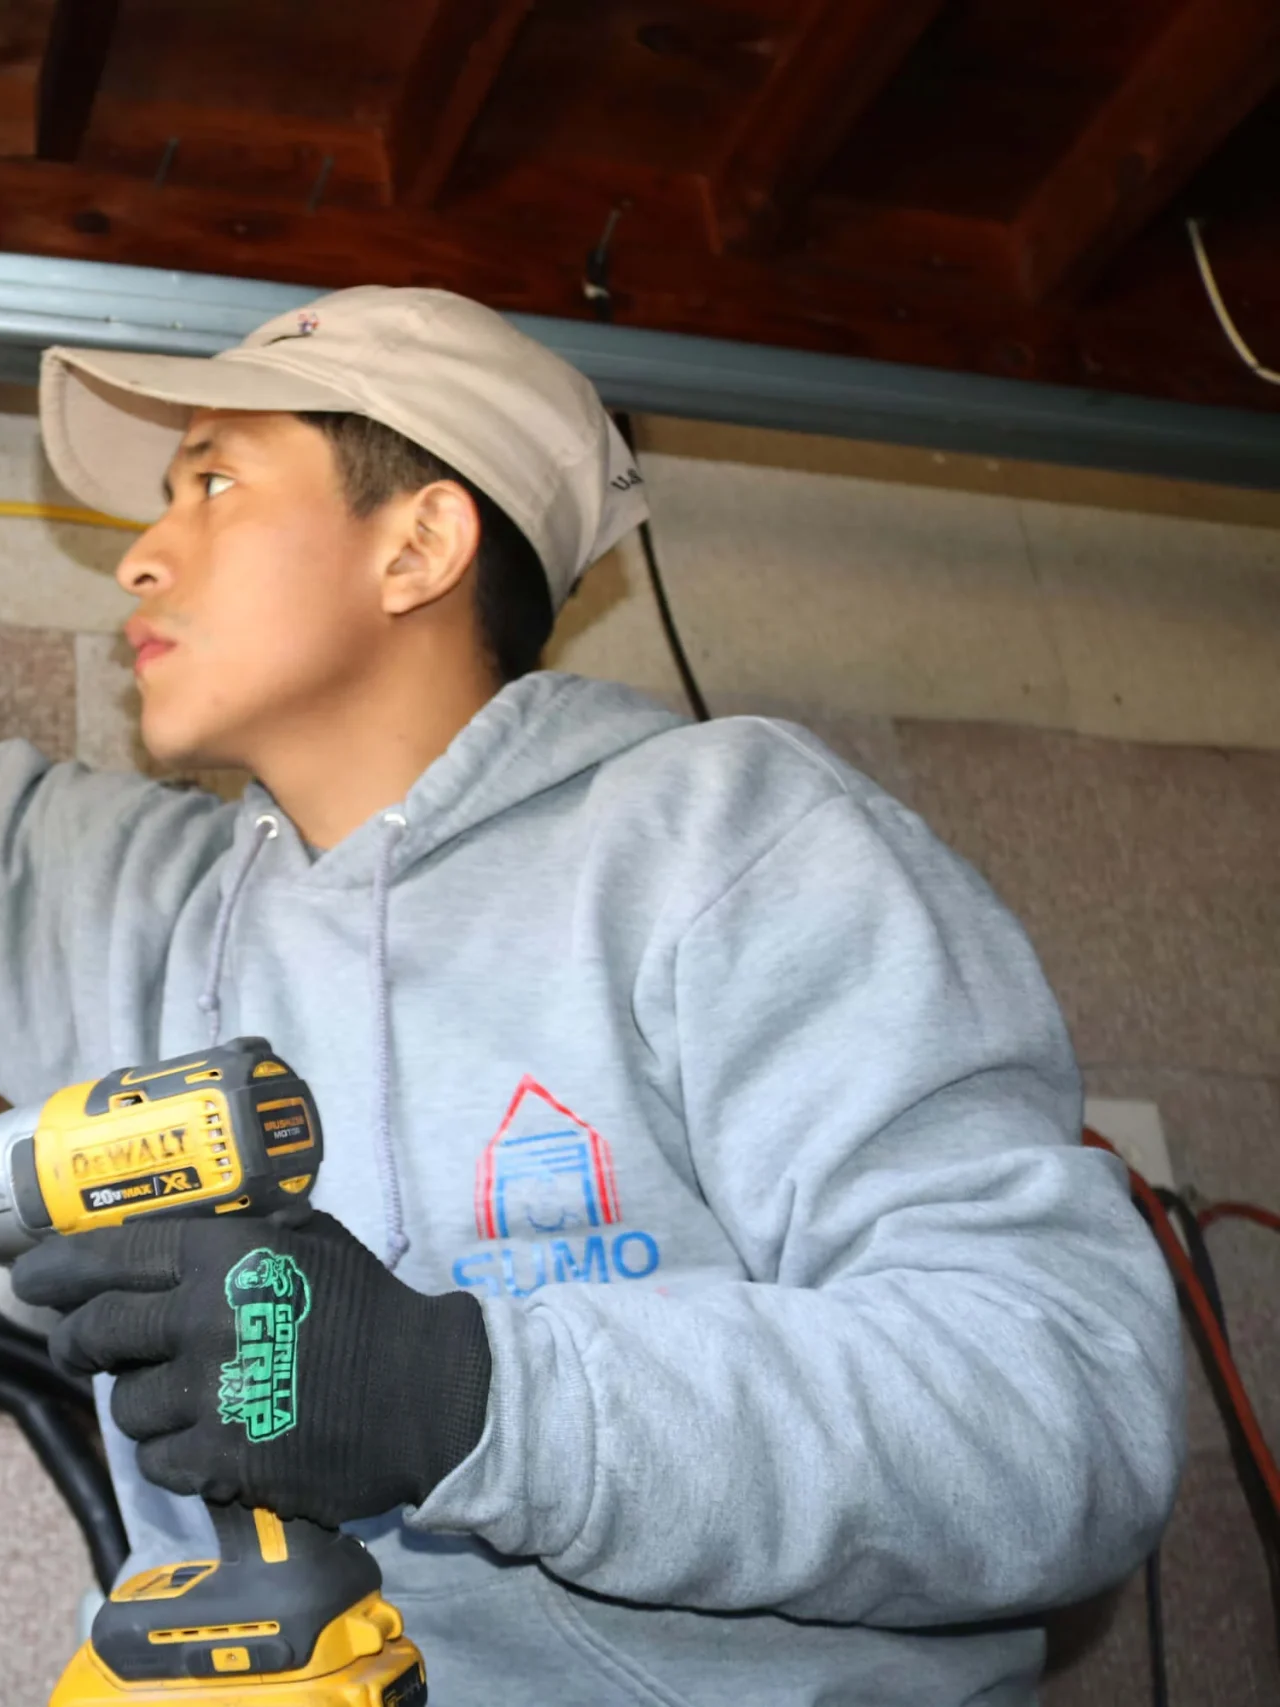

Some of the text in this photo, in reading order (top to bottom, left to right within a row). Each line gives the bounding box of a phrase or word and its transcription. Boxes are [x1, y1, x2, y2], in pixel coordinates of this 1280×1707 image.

[160, 1171, 193, 1194] XR
[452, 1231, 660, 1297] SUMO
[240, 1302, 273, 1436] GRIP
[273, 1303, 294, 1429] GORILLA
